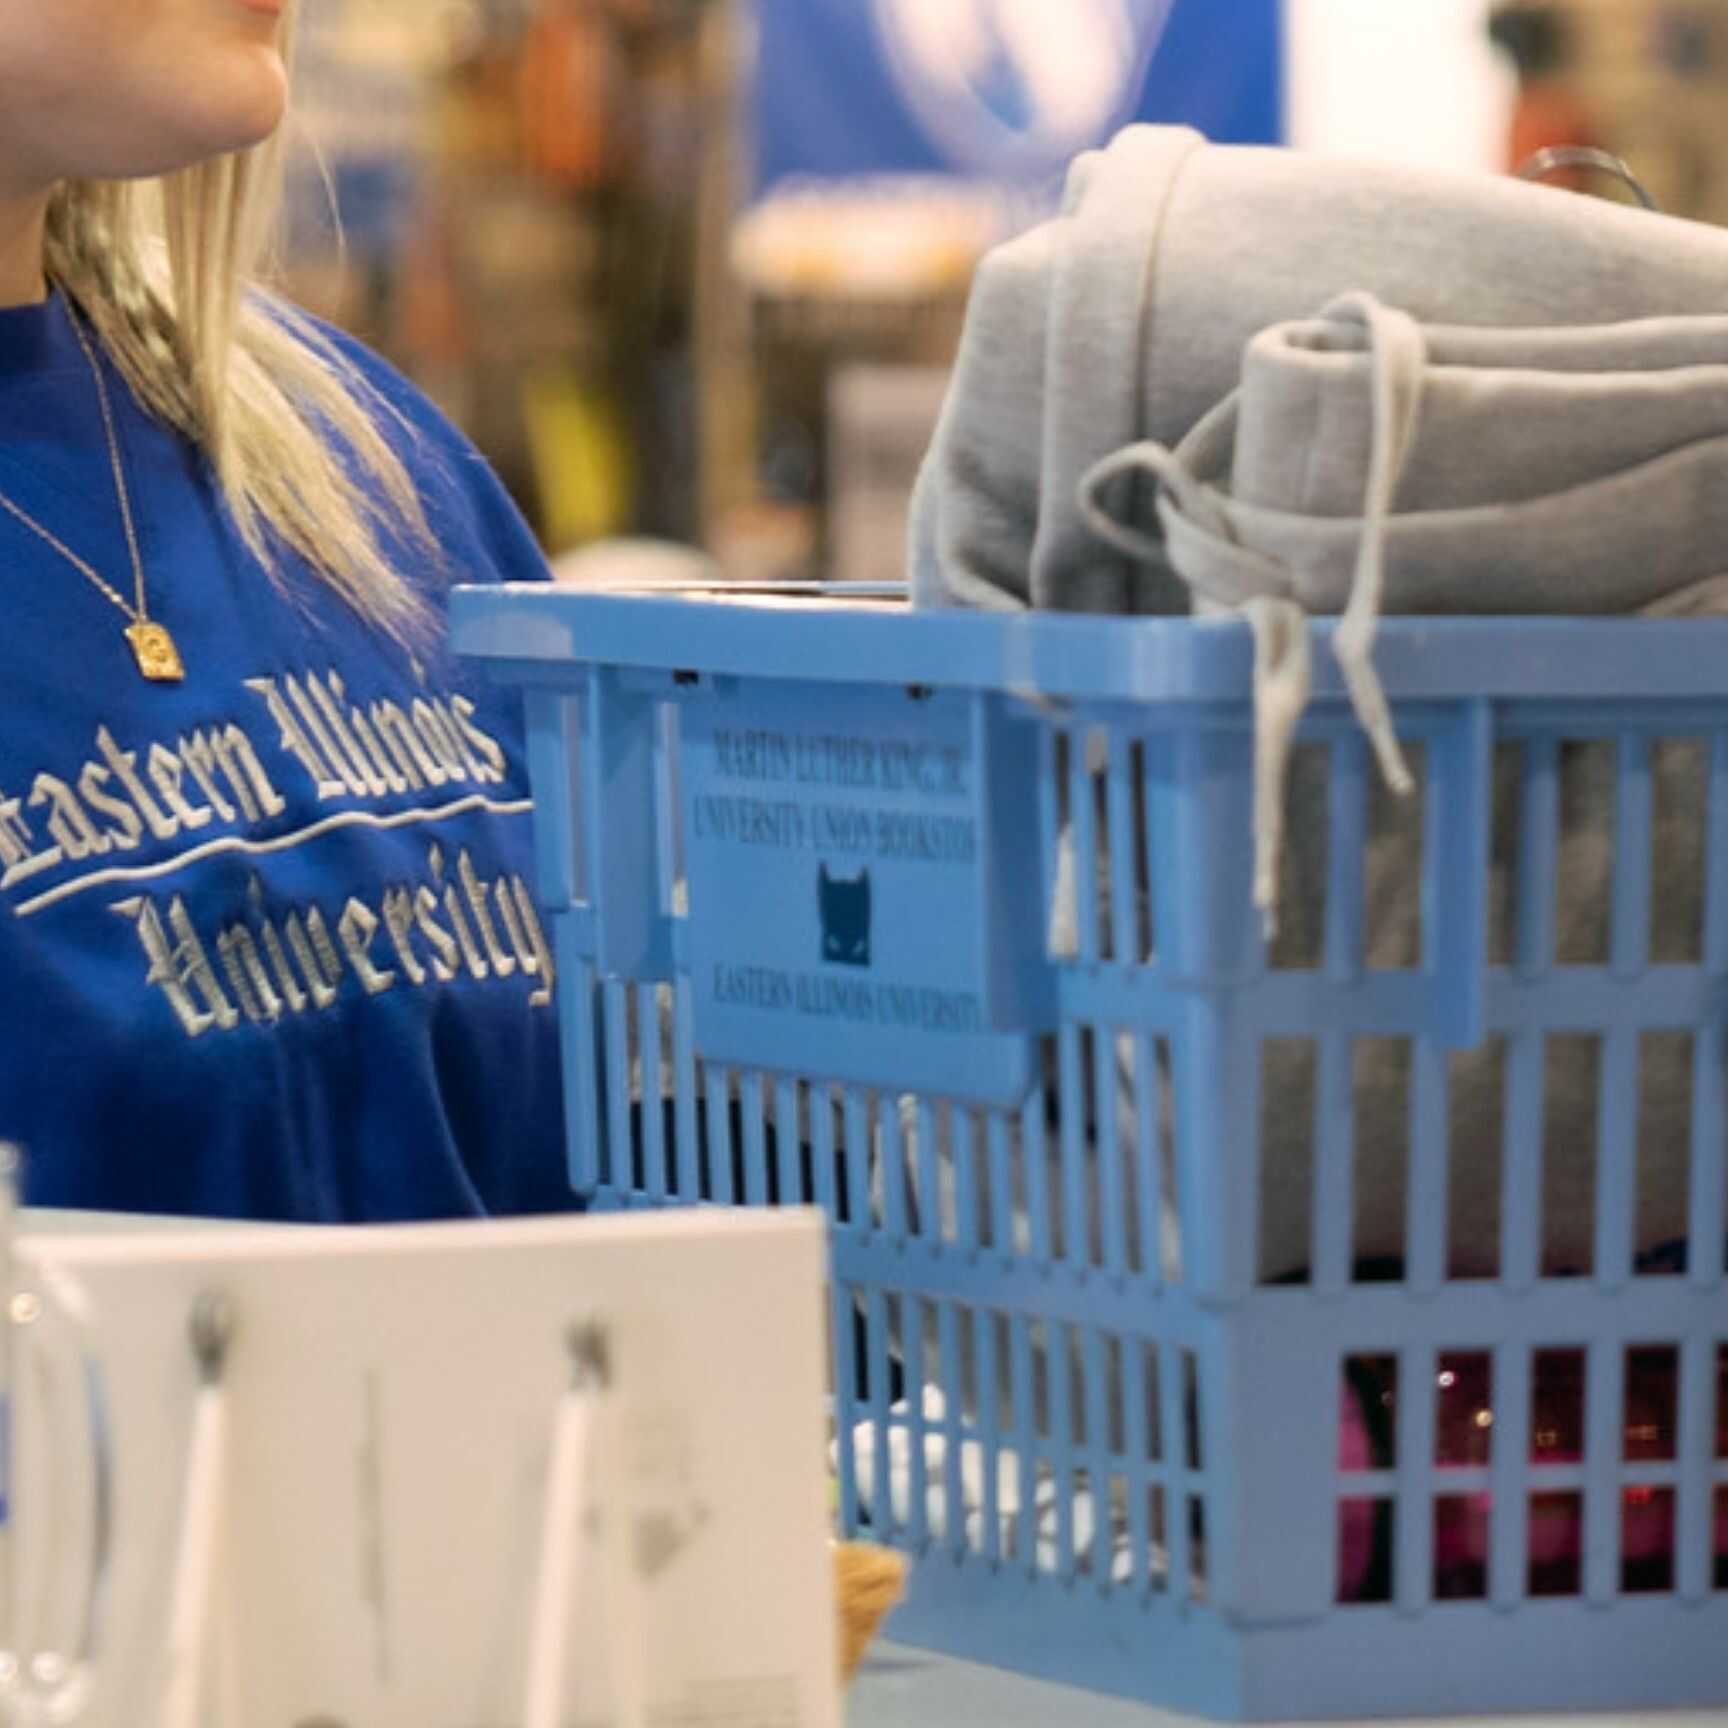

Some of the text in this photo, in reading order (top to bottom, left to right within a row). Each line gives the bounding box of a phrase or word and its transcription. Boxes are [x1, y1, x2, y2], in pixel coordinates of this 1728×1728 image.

[242, 656, 506, 801] Illinois
[712, 727, 792, 781] MARTIN
[795, 732, 876, 788] LUTHER
[693, 794, 805, 849] UNIVERSITY
[812, 803, 872, 857] UNION
[107, 842, 556, 1038] University
[712, 963, 982, 1034] EASTERN ILLINOIS UNIVERSITY
